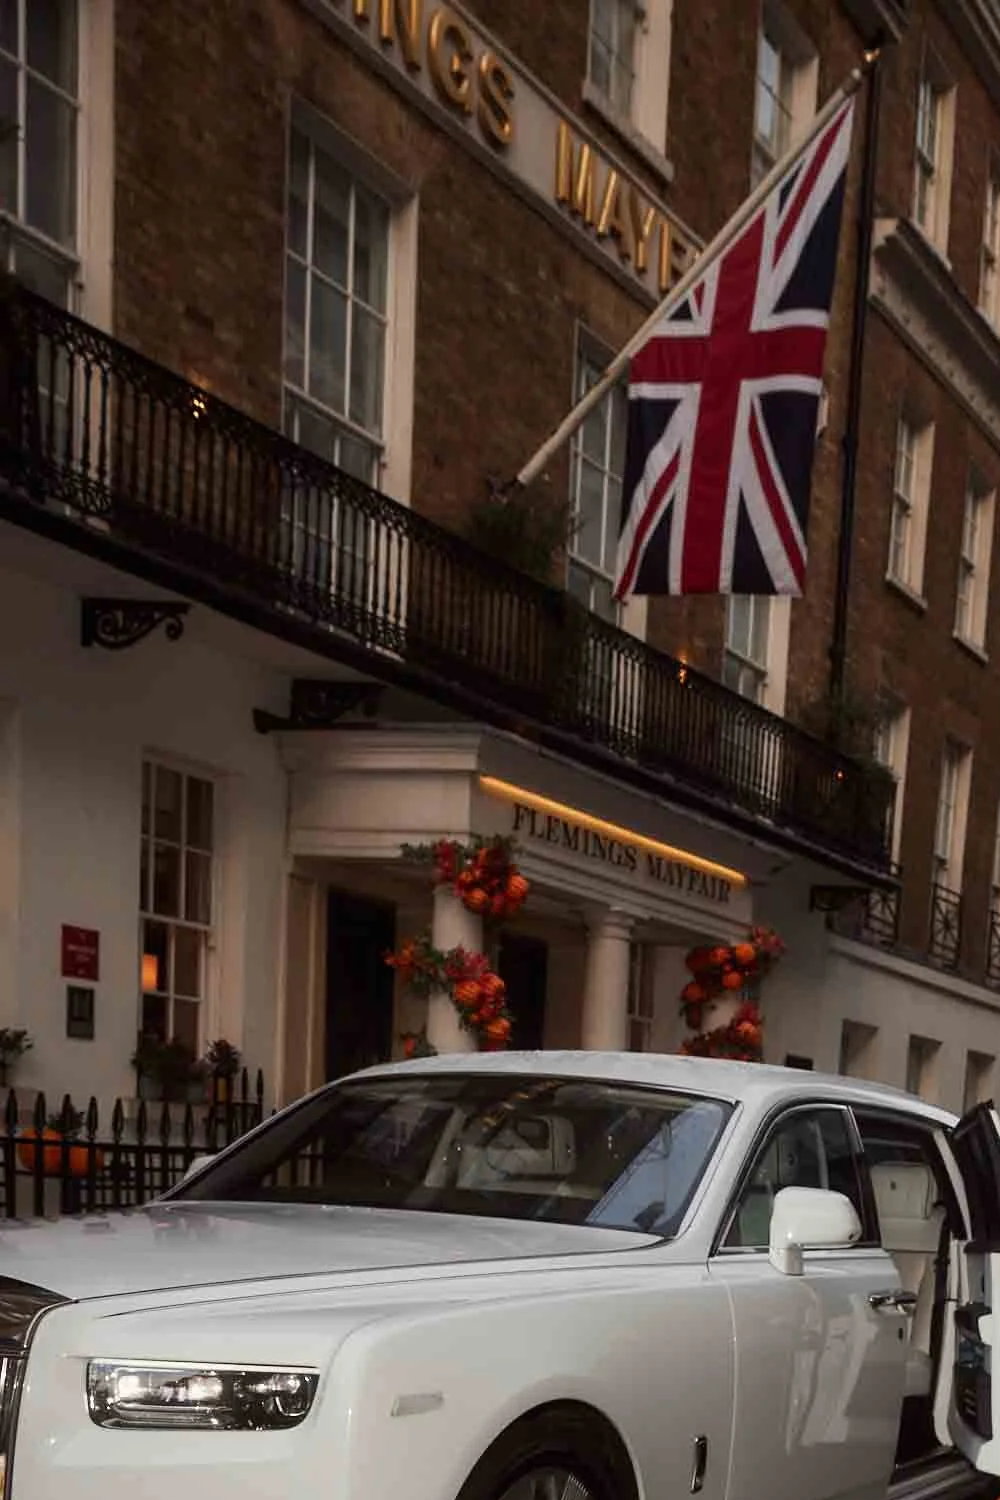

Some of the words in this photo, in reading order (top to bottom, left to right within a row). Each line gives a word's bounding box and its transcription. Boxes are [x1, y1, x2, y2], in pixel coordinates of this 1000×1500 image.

[352, 0, 515, 146] NGS
[556, 119, 704, 293] MAYF
[512, 802, 638, 871] FLEMINGS
[647, 852, 731, 903] MAYFAIR
